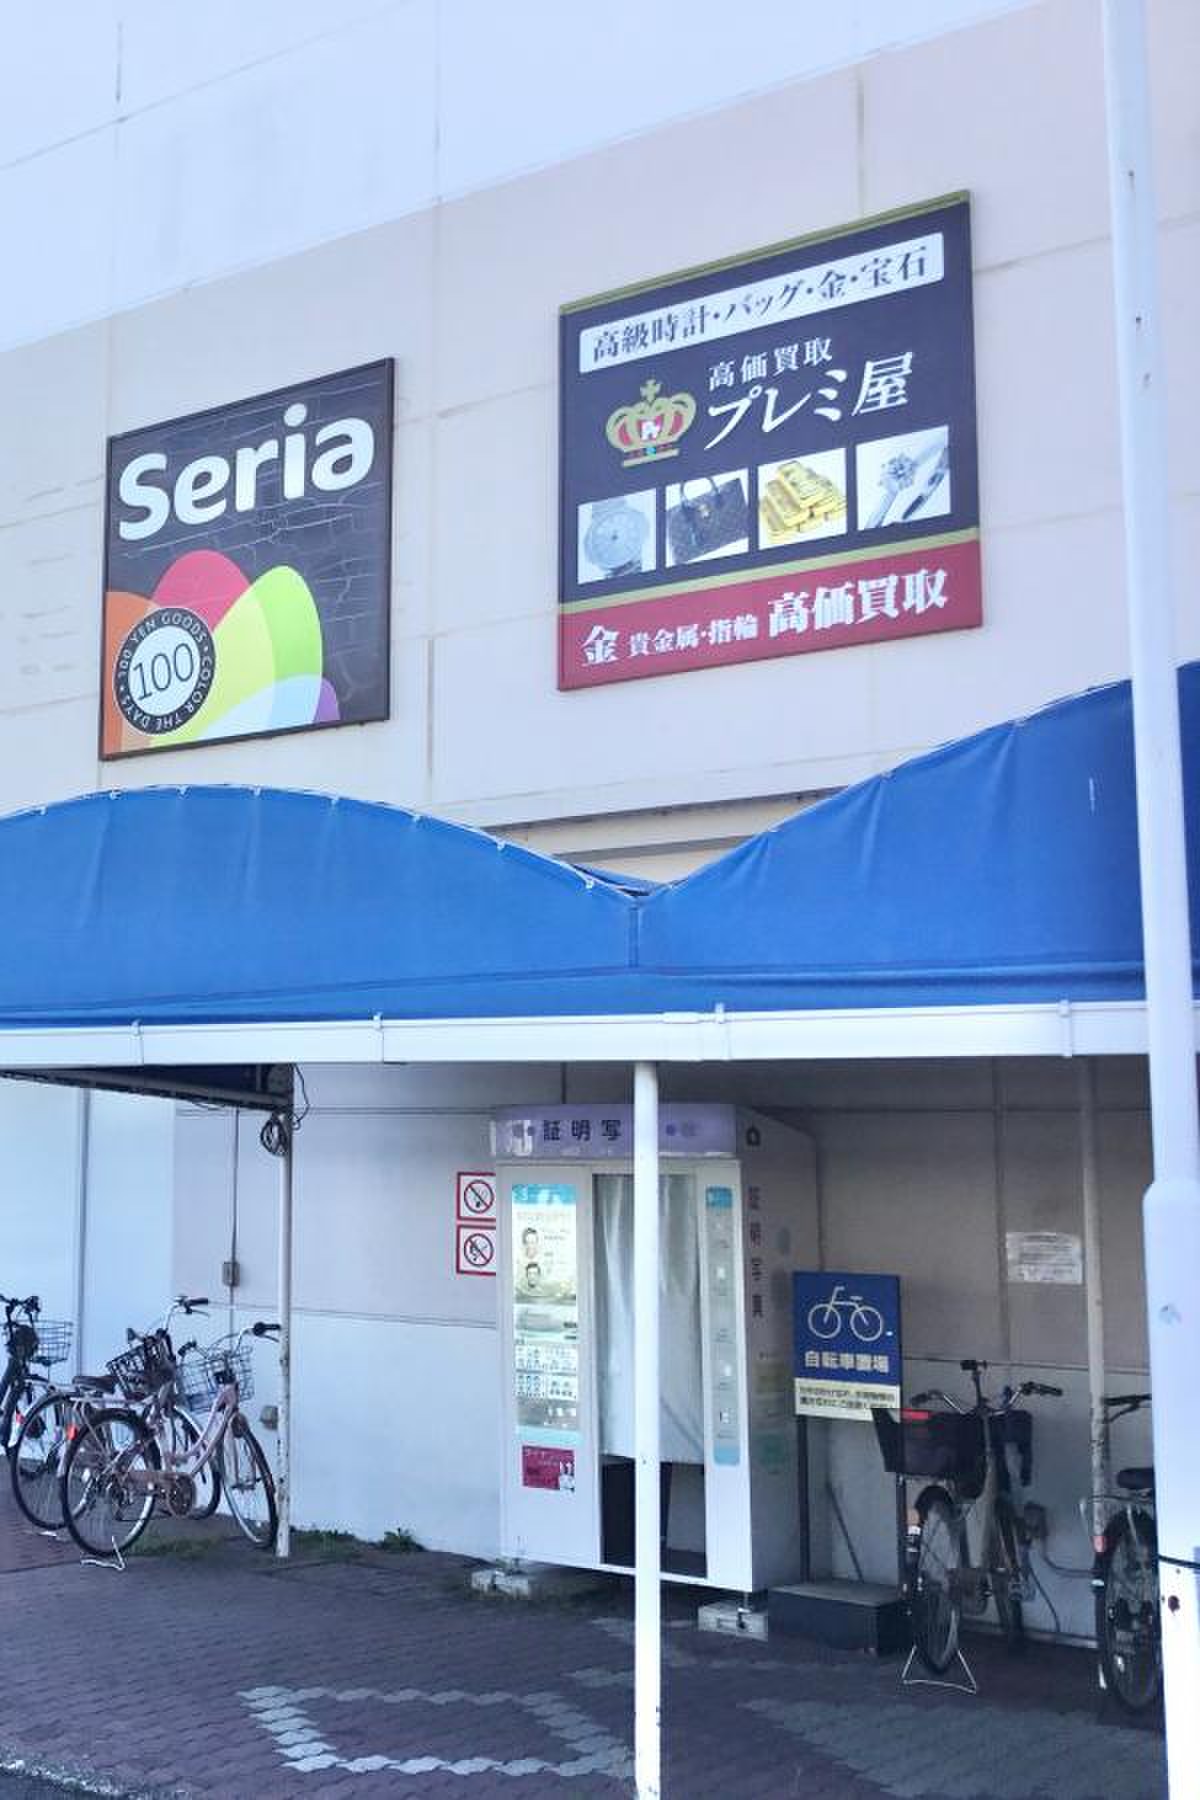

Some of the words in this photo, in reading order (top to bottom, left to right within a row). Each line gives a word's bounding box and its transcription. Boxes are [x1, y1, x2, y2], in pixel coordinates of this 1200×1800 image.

[593, 246, 928, 362] 高級時計・バッグ・金・宝石
[709, 337, 833, 391] 高価買取
[704, 352, 913, 450] プレミ屋
[119, 403, 375, 541] Seria
[130, 619, 156, 643] YEN
[161, 612, 208, 643] GOODS
[581, 625, 619, 668] 金
[768, 568, 949, 639] 高価買取
[132, 642, 194, 701] 100
[183, 656, 213, 713] COLOR
[543, 1119, 622, 1142] 証明写
